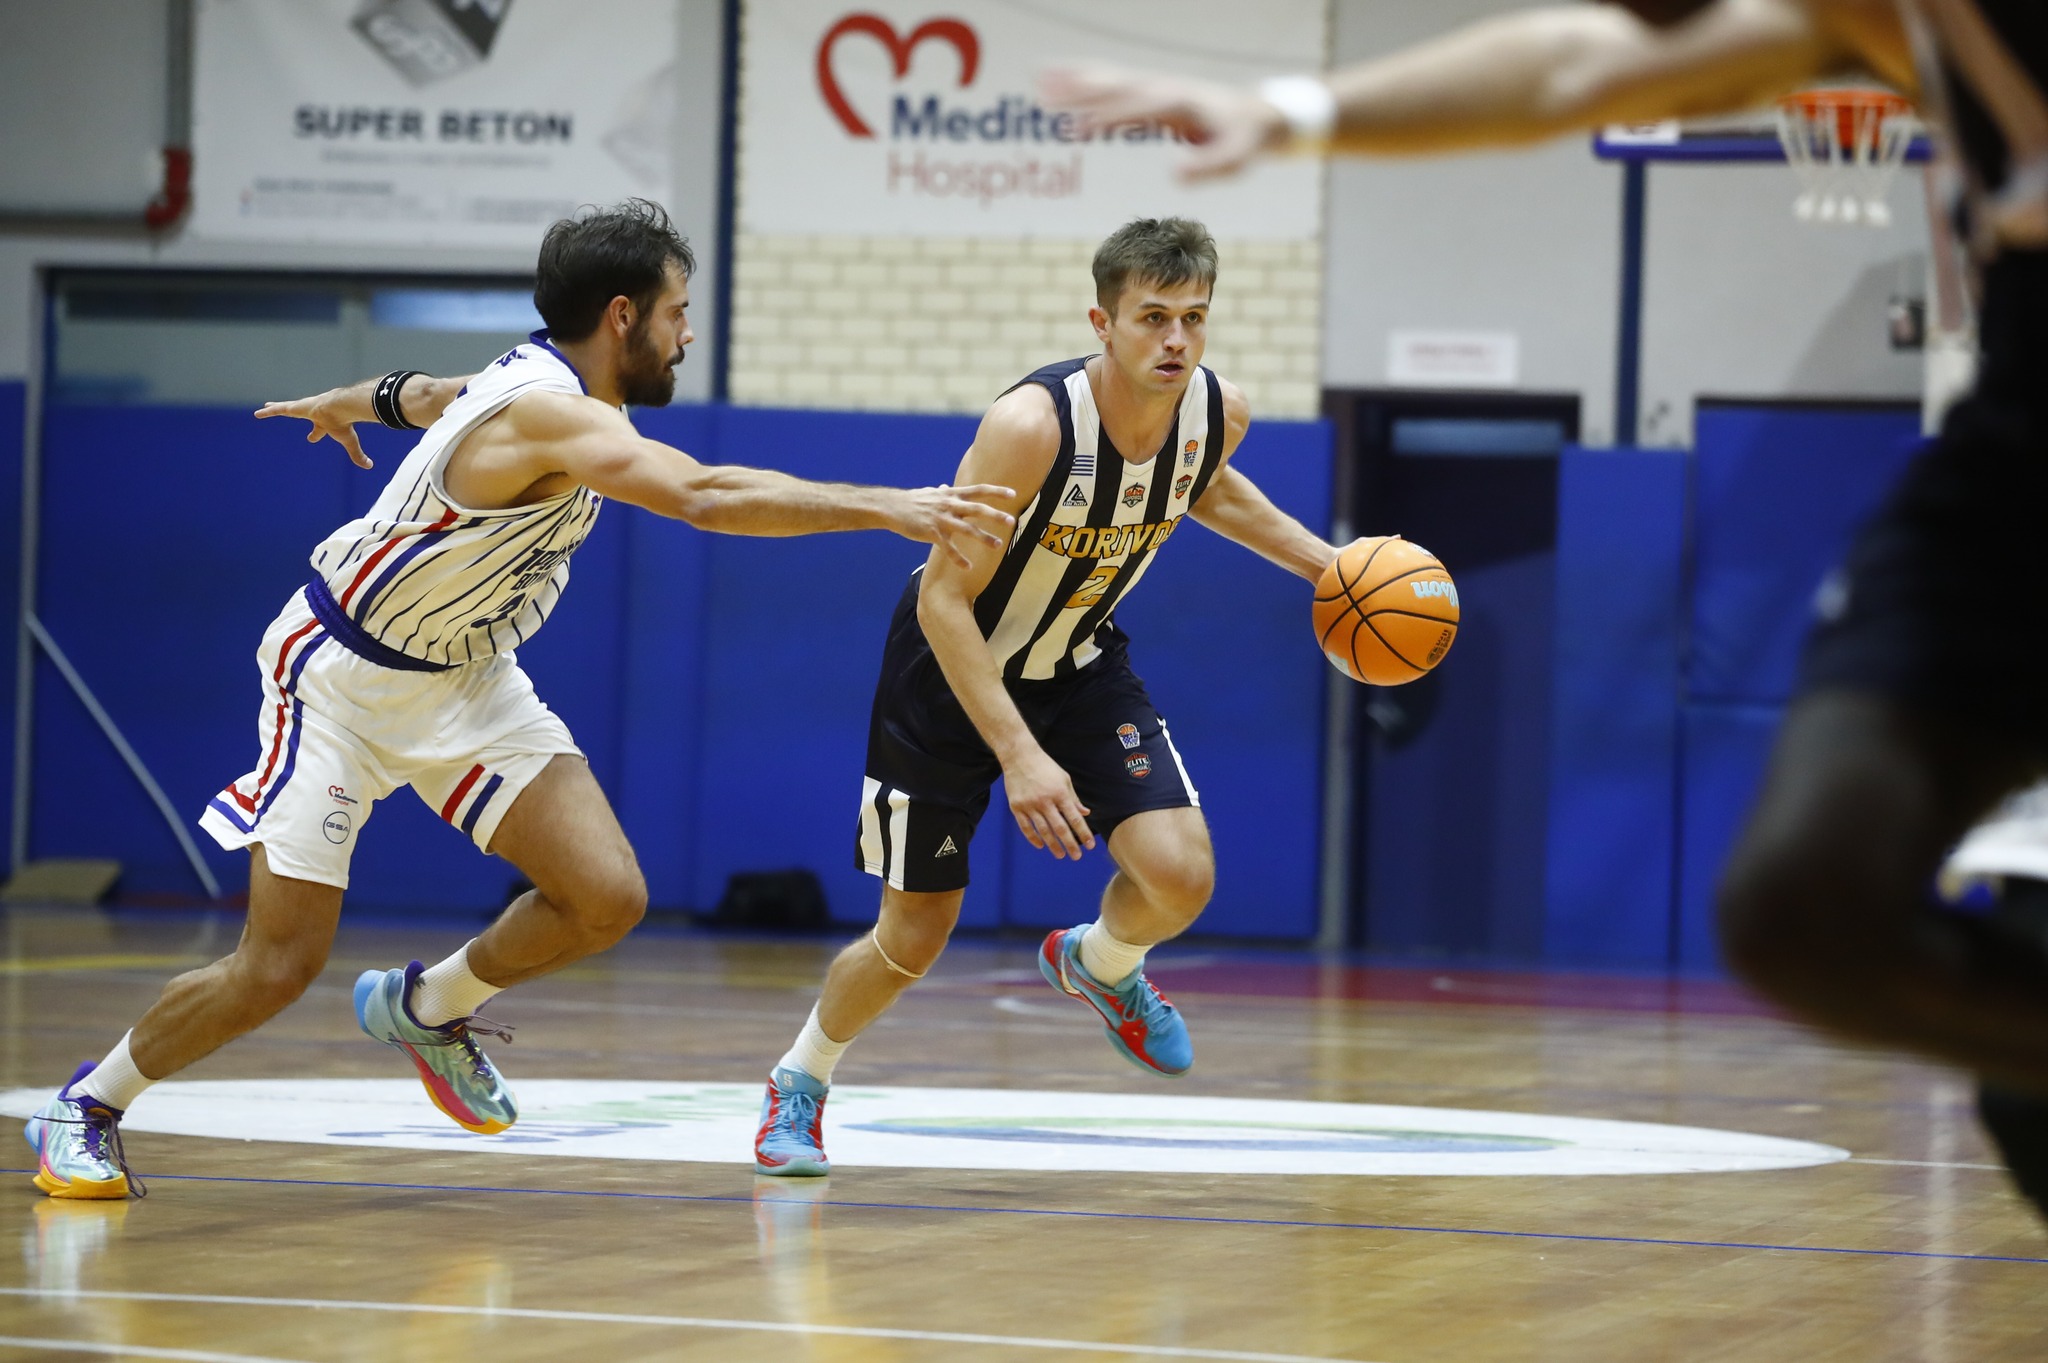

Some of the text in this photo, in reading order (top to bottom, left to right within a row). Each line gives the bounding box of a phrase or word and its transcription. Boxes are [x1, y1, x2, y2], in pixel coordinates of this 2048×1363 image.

[295, 106, 573, 143] SUPER BETON
[888, 151, 1083, 206] Hospital
[1064, 566, 1120, 609] 2
[1127, 757, 1149, 768] ELITE
